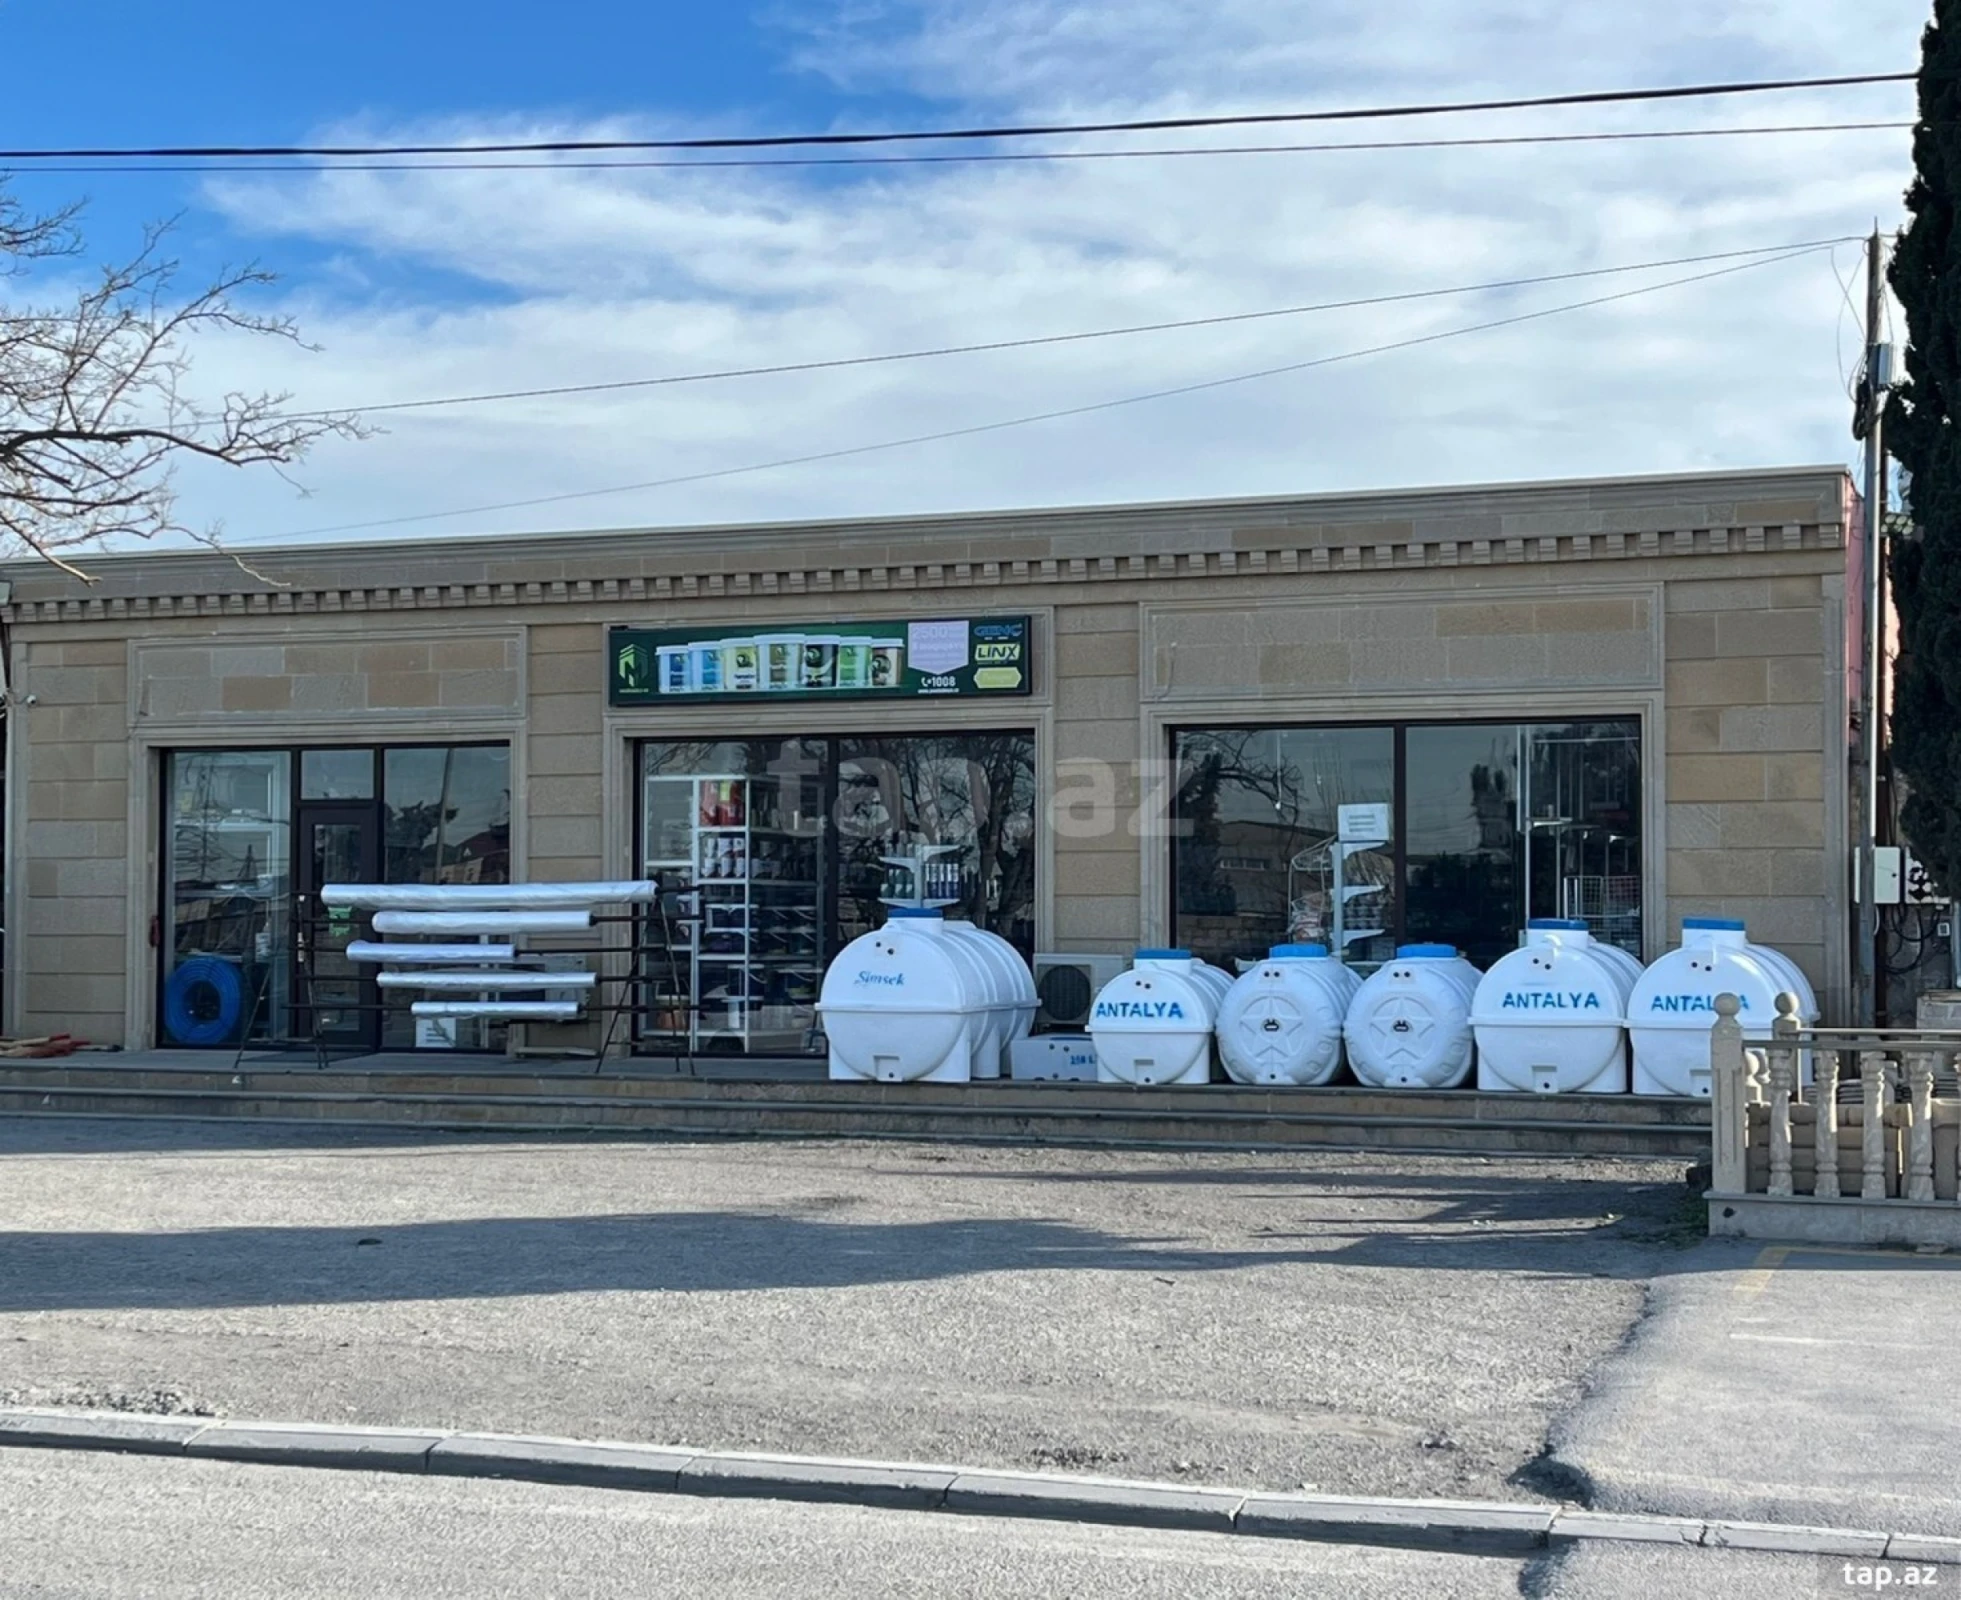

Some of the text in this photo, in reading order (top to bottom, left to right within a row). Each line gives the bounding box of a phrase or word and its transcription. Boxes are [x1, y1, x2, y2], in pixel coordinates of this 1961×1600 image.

[977, 645, 1019, 659] LINX
[1502, 992, 1600, 1009] ANTALYA
[1651, 995, 1749, 1011] ANTALA
[1096, 1002, 1183, 1018] ANTALYA
